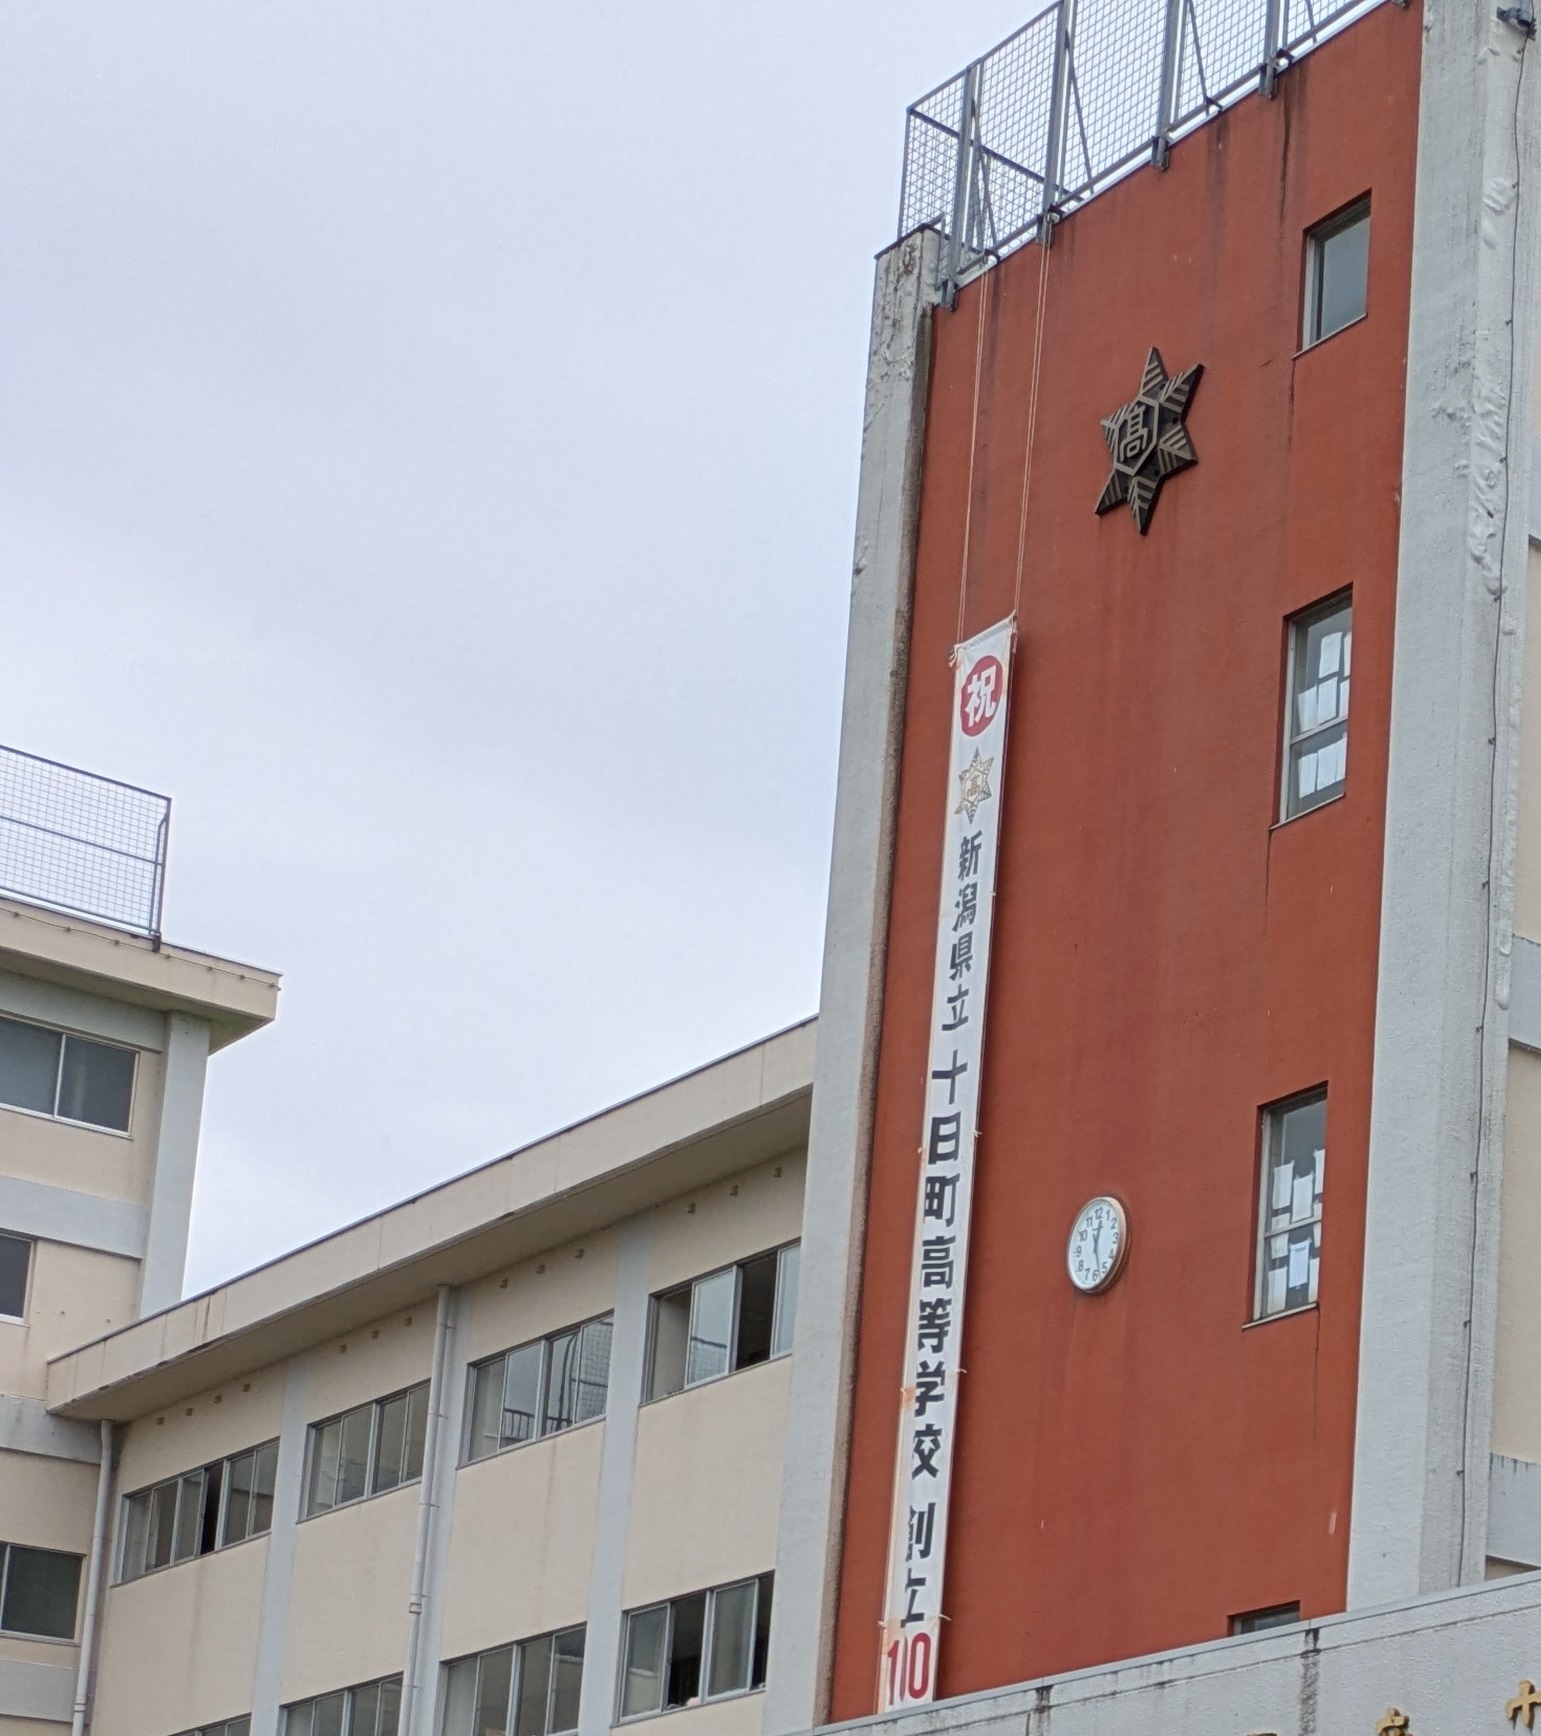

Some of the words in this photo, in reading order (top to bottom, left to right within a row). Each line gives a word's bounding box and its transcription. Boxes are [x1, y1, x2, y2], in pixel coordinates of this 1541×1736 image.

[966, 663, 998, 727] 祝
[1094, 1207, 1103, 1220] 12
[1106, 1209, 1111, 1221] 1
[1086, 1216, 1093, 1228] 11
[1111, 1218, 1117, 1230] 2
[1079, 1229, 1088, 1242] 10
[1113, 1232, 1119, 1244] 3
[1076, 1245, 1082, 1258] 9
[1108, 1248, 1114, 1260] 4
[1078, 1260, 1084, 1272] 8
[1102, 1262, 1107, 1274] 5
[1085, 1268, 1091, 1280] 7
[1092, 1270, 1100, 1281] 6
